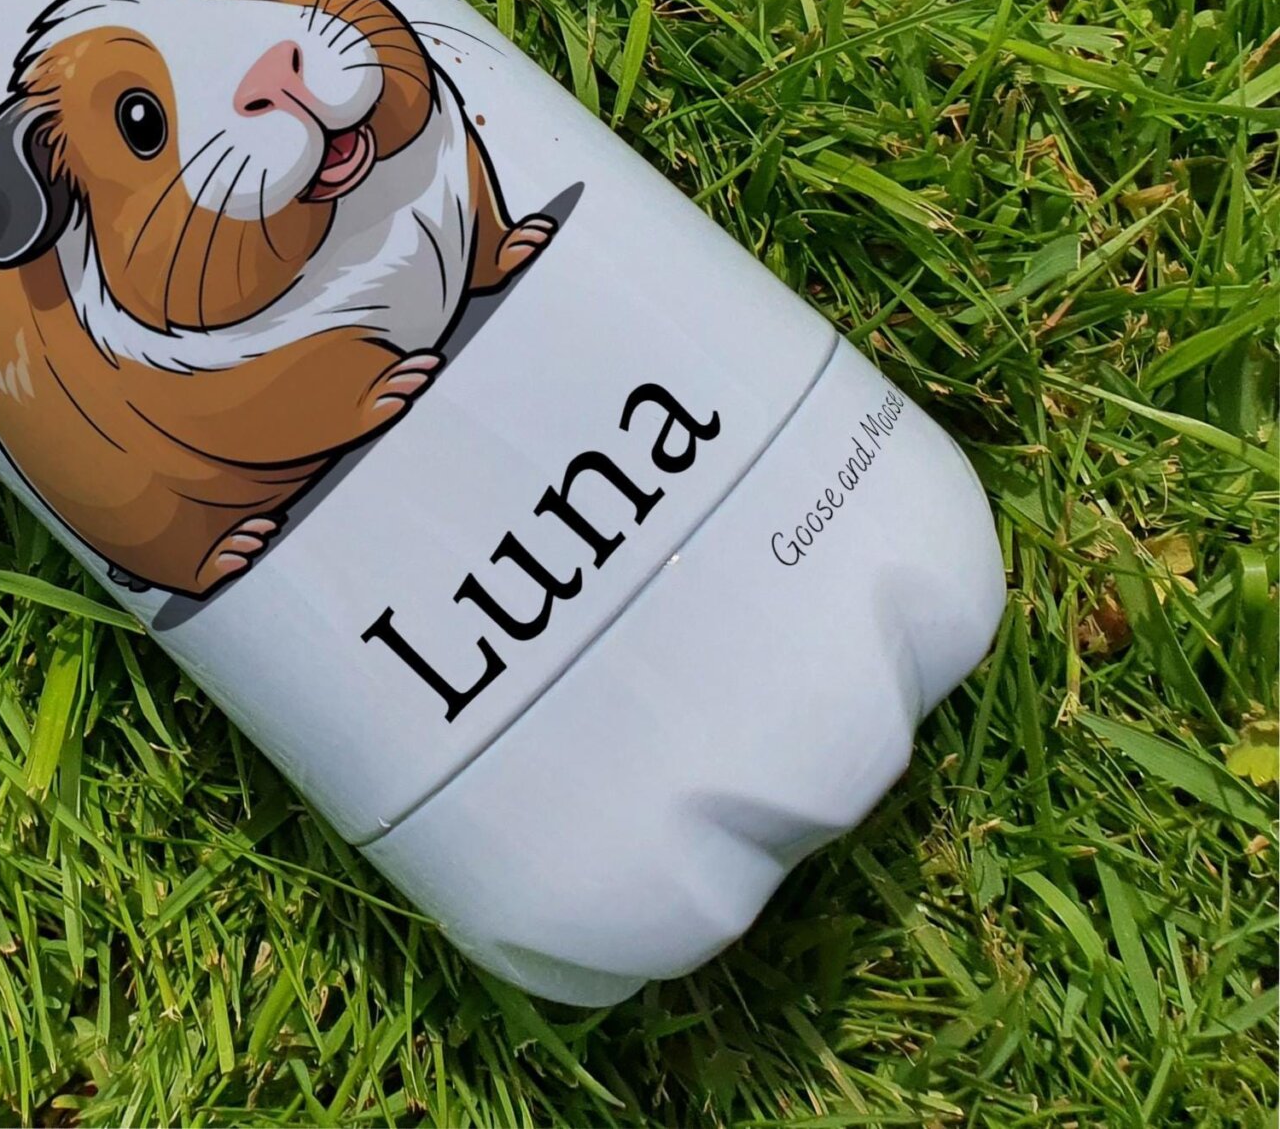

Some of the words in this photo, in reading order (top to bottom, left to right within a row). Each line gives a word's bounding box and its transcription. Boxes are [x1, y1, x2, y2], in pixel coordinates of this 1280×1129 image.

[360, 383, 721, 724] Luna
[771, 488, 844, 566] Goose
[838, 436, 876, 491] and
[859, 390, 904, 450] Moose
